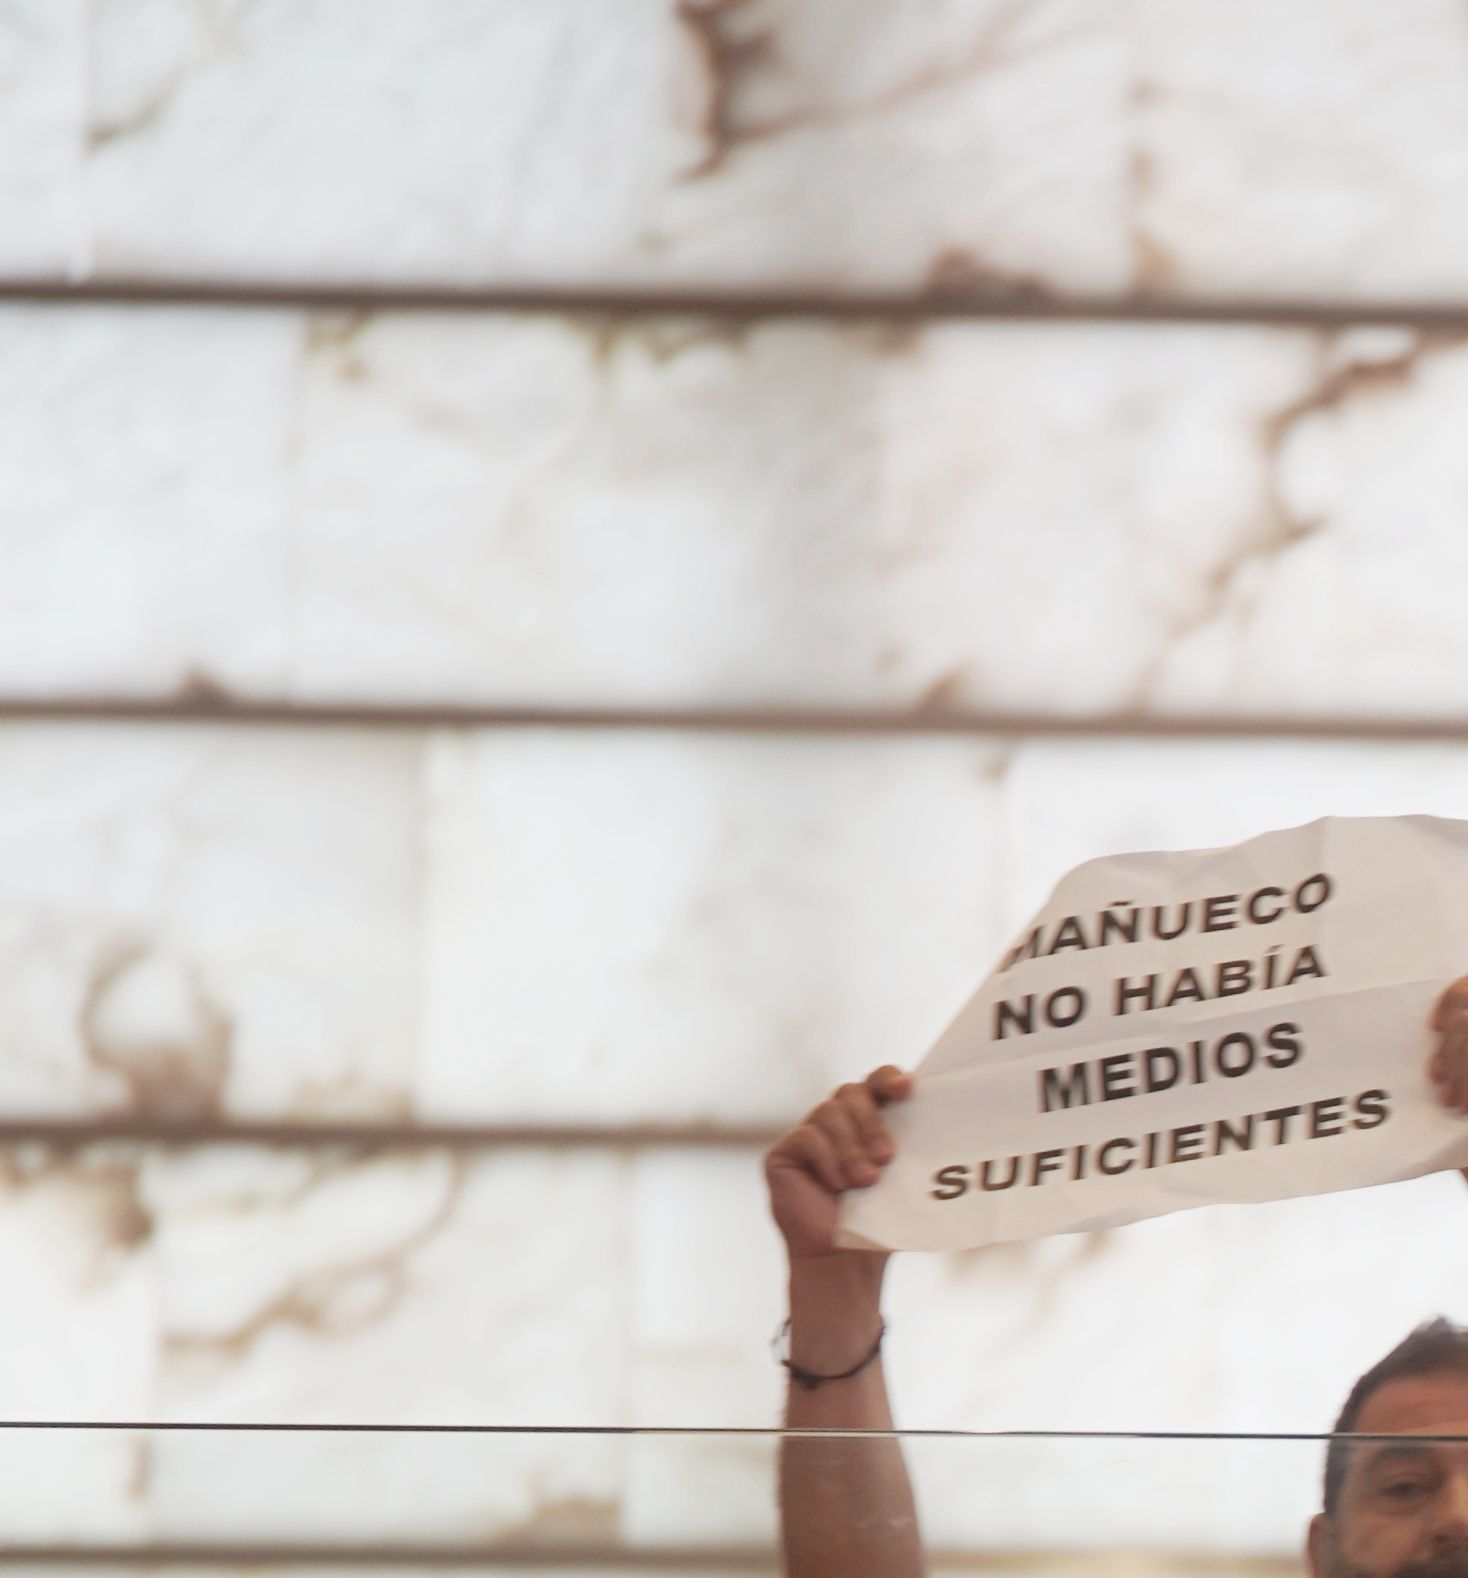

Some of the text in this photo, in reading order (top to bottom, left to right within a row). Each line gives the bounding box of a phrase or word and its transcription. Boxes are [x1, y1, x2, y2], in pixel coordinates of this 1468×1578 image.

[992, 945, 1327, 1040] NO HABÍA
[1038, 1022, 1303, 1113] MEDIOS
[930, 1088, 1392, 1202] SUFICIENTES
